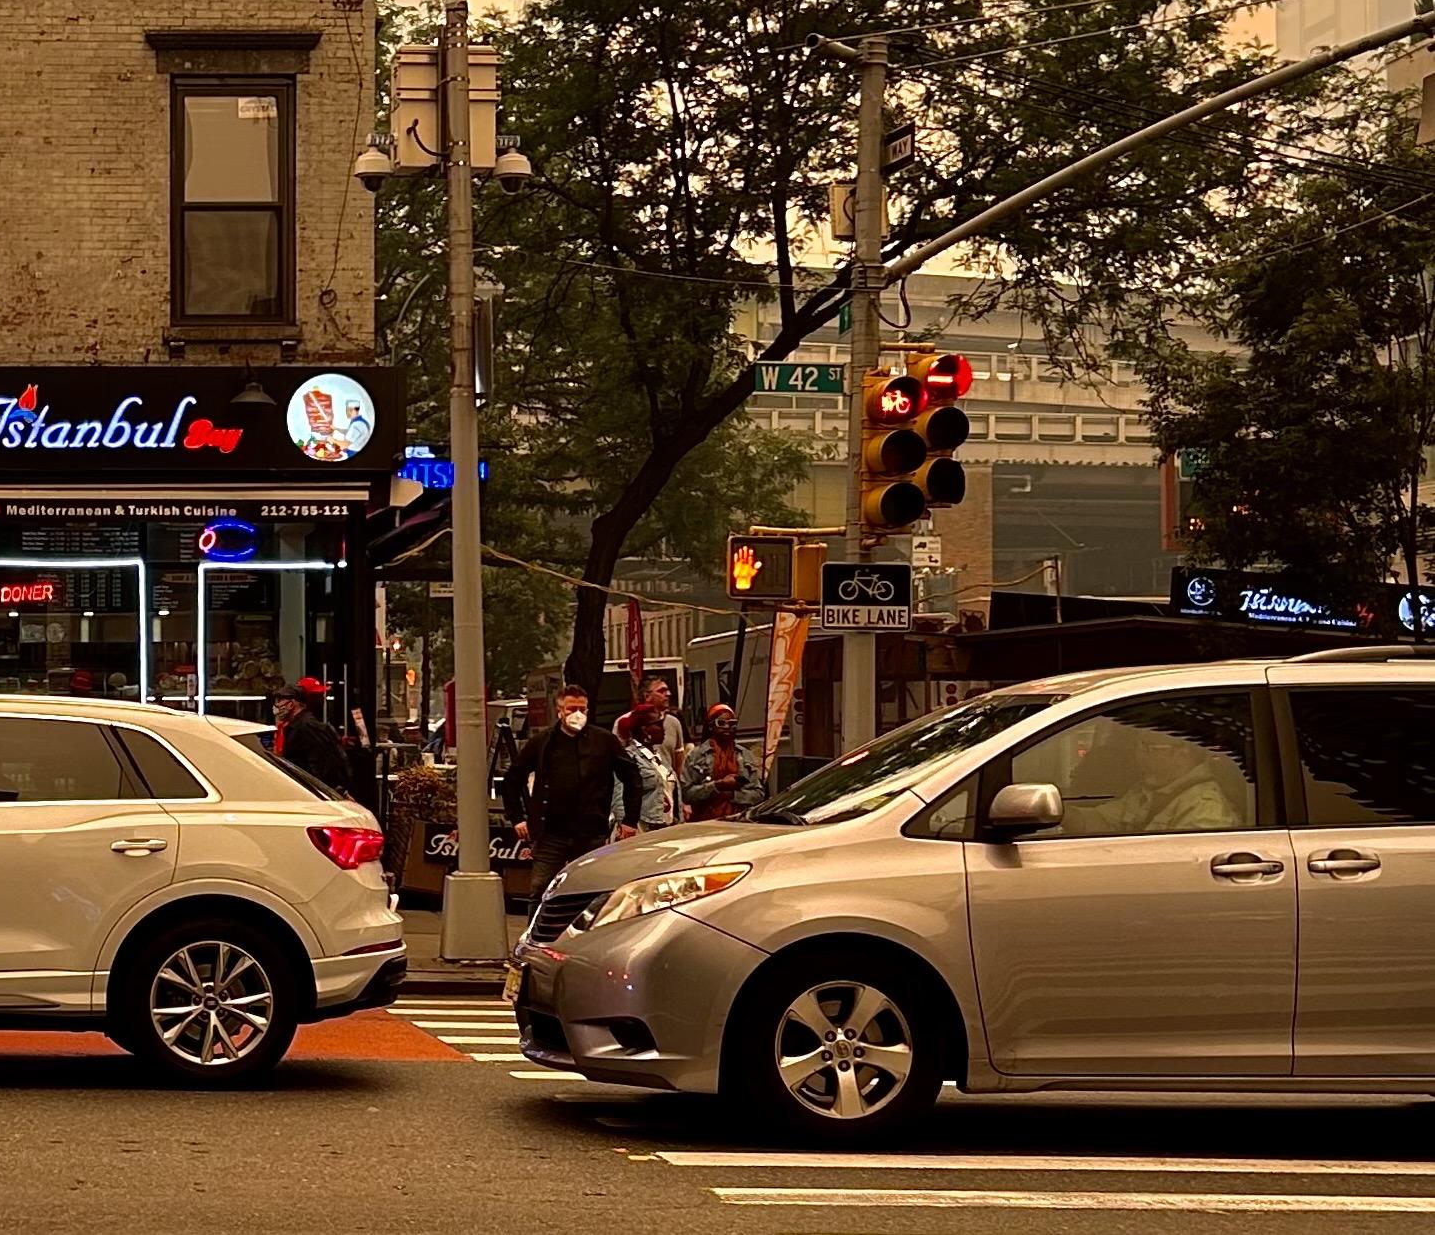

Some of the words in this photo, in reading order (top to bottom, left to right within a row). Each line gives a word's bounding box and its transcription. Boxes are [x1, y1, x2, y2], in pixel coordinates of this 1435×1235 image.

[761, 367, 778, 390] W
[788, 367, 819, 391] 42
[829, 368, 842, 382] ST
[6, 504, 111, 516] Mediterranean
[115, 505, 125, 516] &
[128, 505, 180, 516] Turkish
[183, 505, 237, 517] Cuisine
[0, 584, 54, 603] DONER
[826, 608, 860, 624] BIKE
[867, 608, 906, 625] LANE
